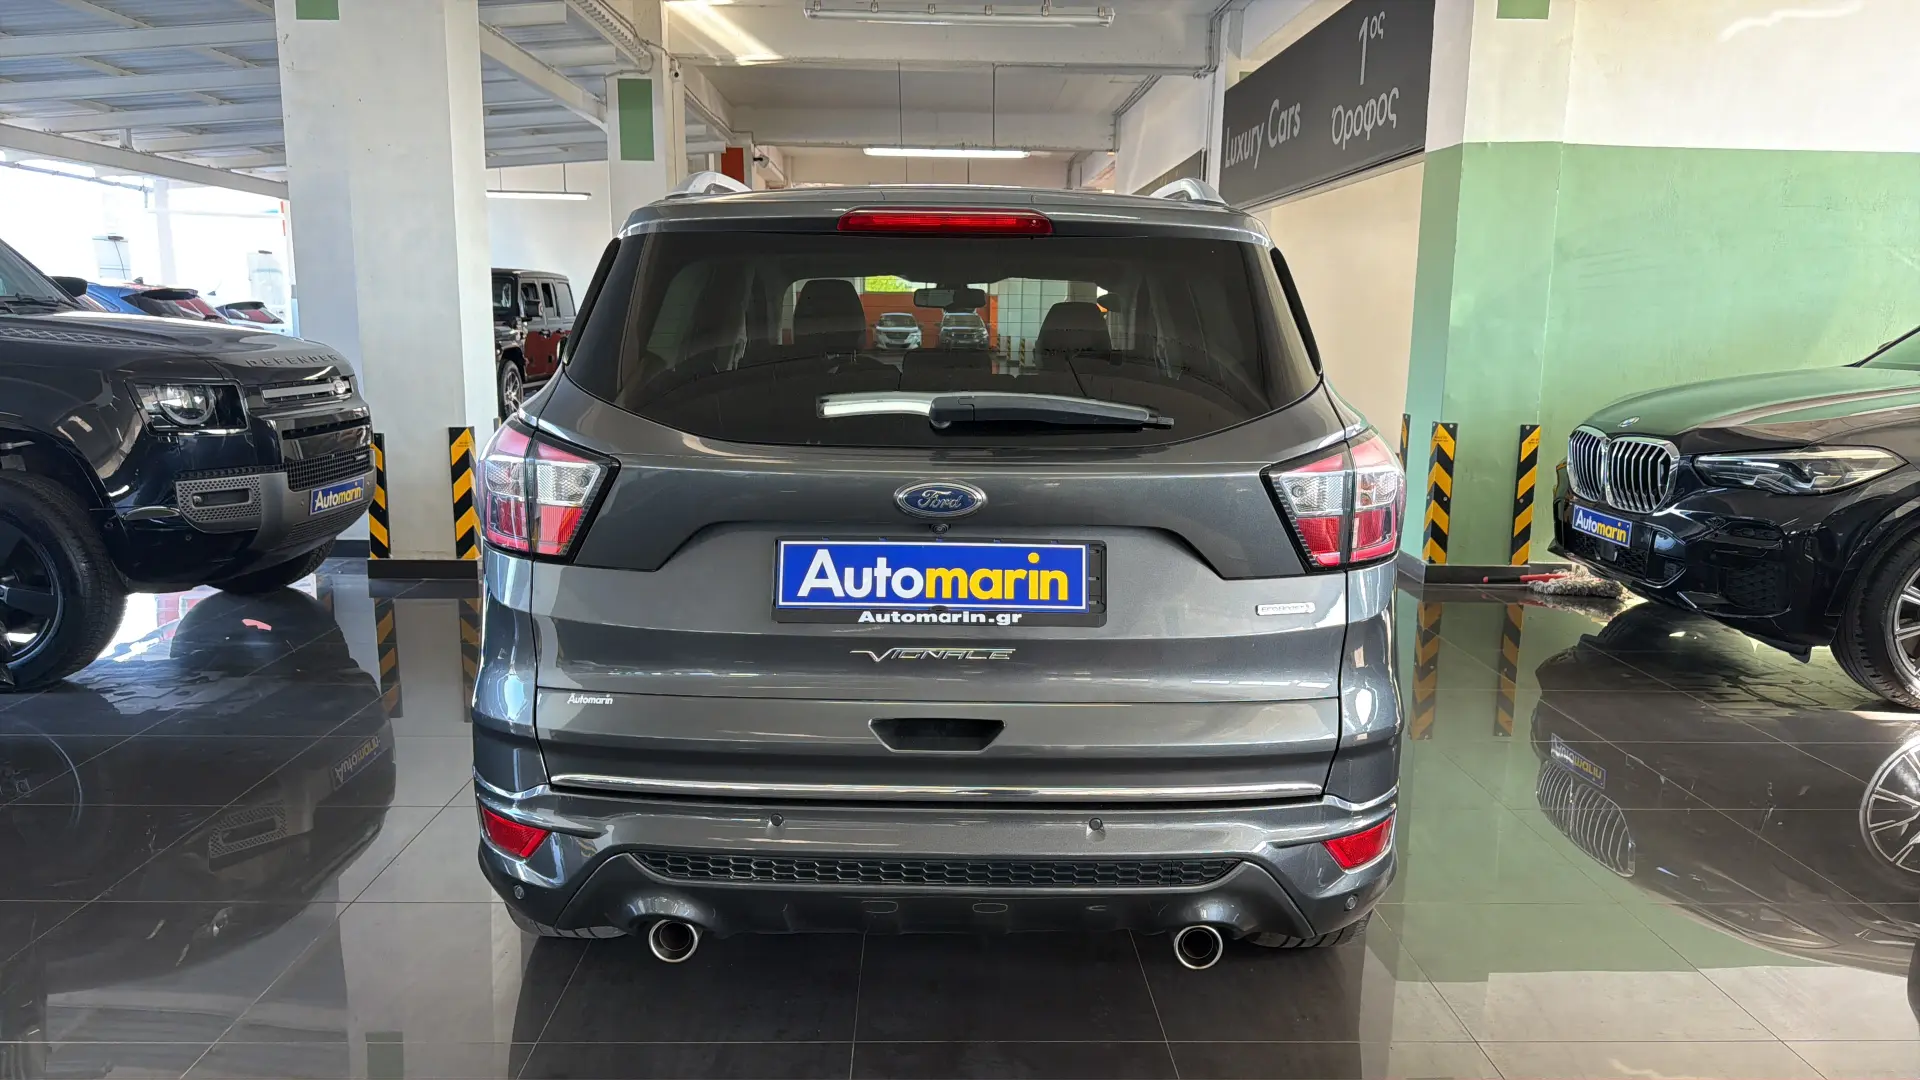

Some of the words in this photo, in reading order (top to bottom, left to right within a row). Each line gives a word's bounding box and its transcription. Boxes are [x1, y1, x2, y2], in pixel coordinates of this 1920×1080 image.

[1331, 87, 1399, 150] Όροφος
[1224, 122, 1265, 170] Luxury
[1267, 98, 1301, 148] Cars
[246, 354, 339, 367] DEFENDER
[314, 482, 363, 511] Automarin
[917, 489, 963, 510] Ford
[1575, 509, 1627, 543] Automarin
[797, 549, 1069, 601] Automarin
[857, 610, 1023, 625] Automarin.gr
[850, 647, 1016, 662] VIGNALE
[566, 692, 614, 705] Automarin
